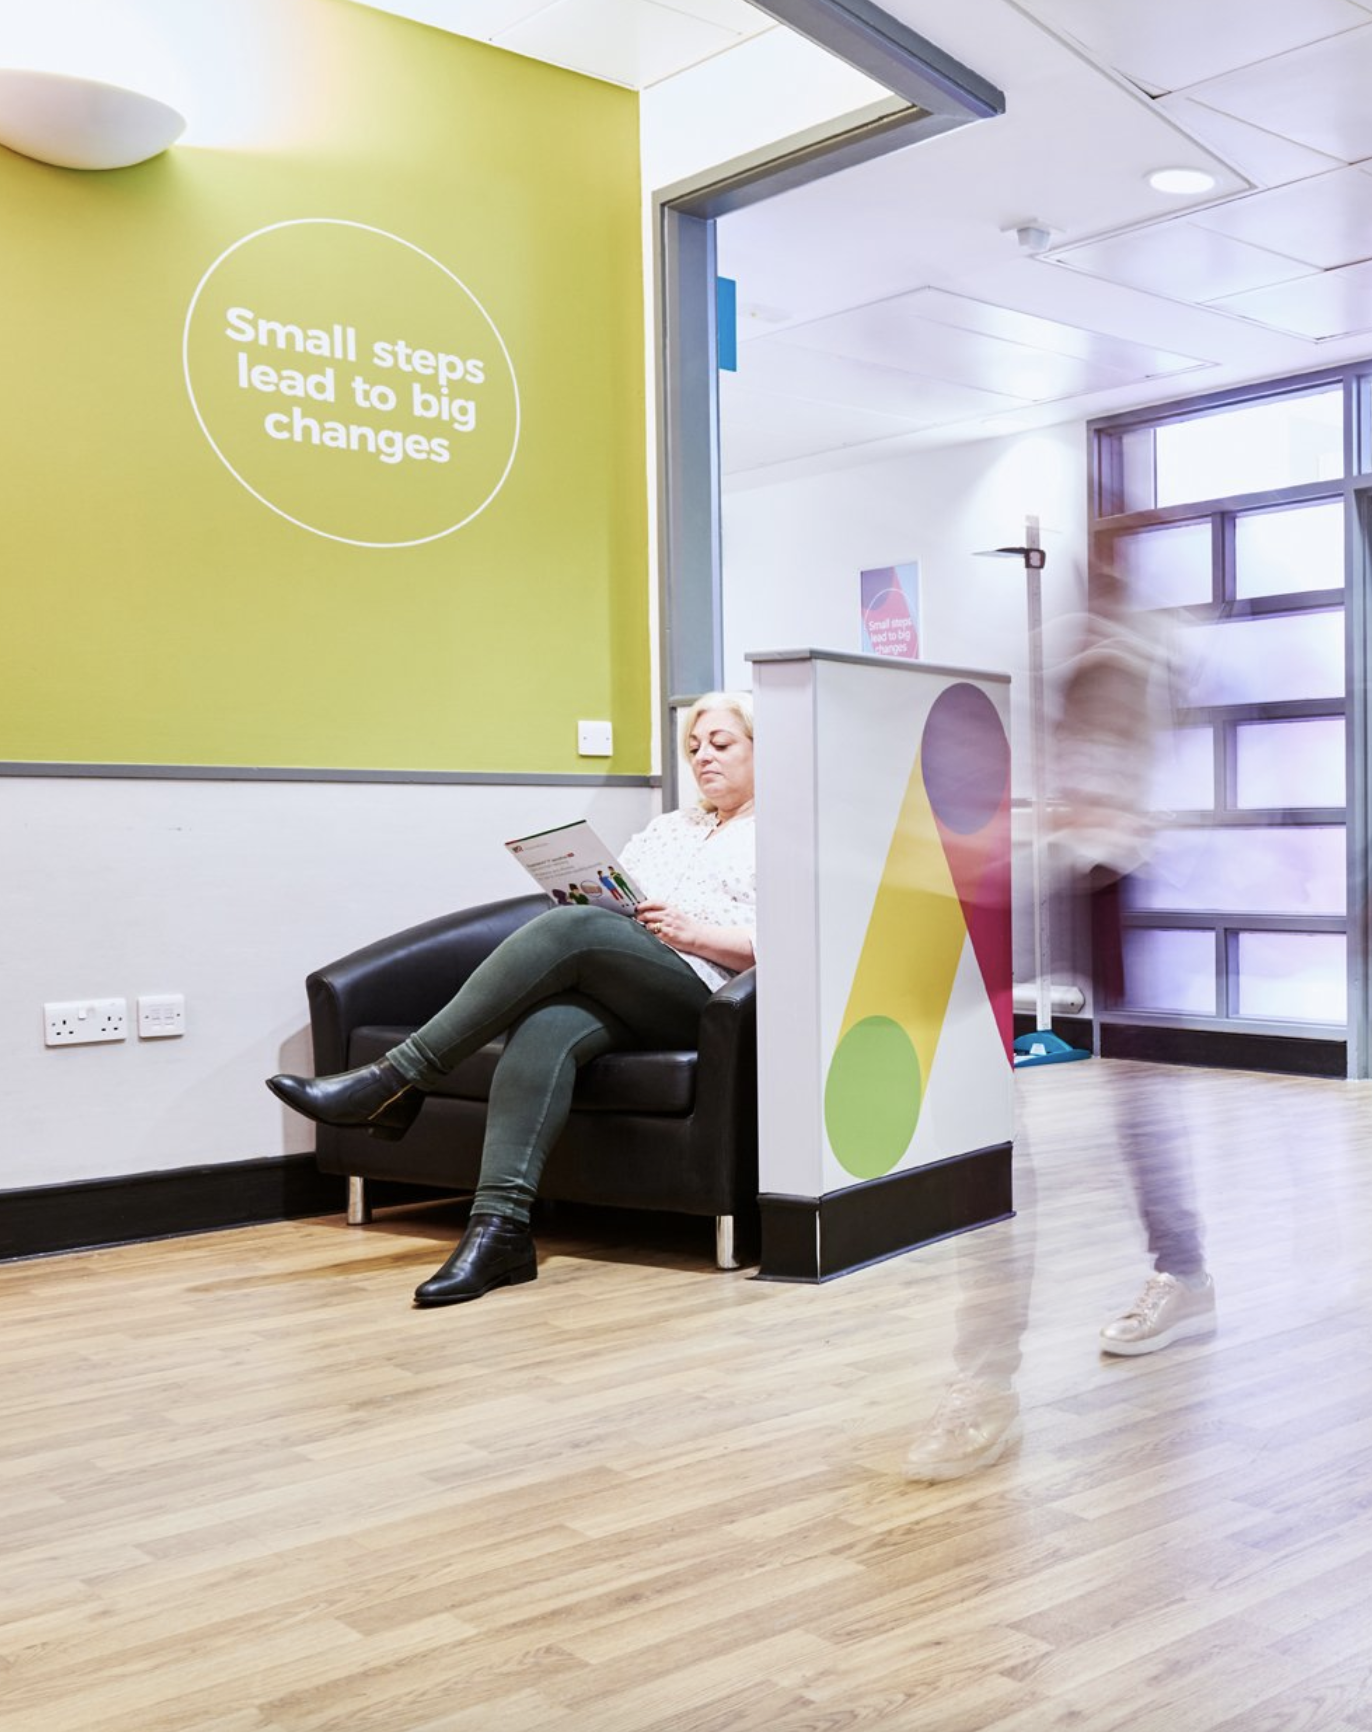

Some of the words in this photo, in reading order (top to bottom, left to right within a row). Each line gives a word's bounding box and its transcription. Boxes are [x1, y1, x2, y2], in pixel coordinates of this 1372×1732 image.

[225, 306, 357, 362] Small
[372, 340, 485, 386] steps
[238, 352, 335, 402] lead
[352, 376, 397, 412] to
[411, 382, 476, 432] big
[264, 406, 450, 464] changes
[888, 633, 898, 641] to
[897, 629, 912, 642] big
